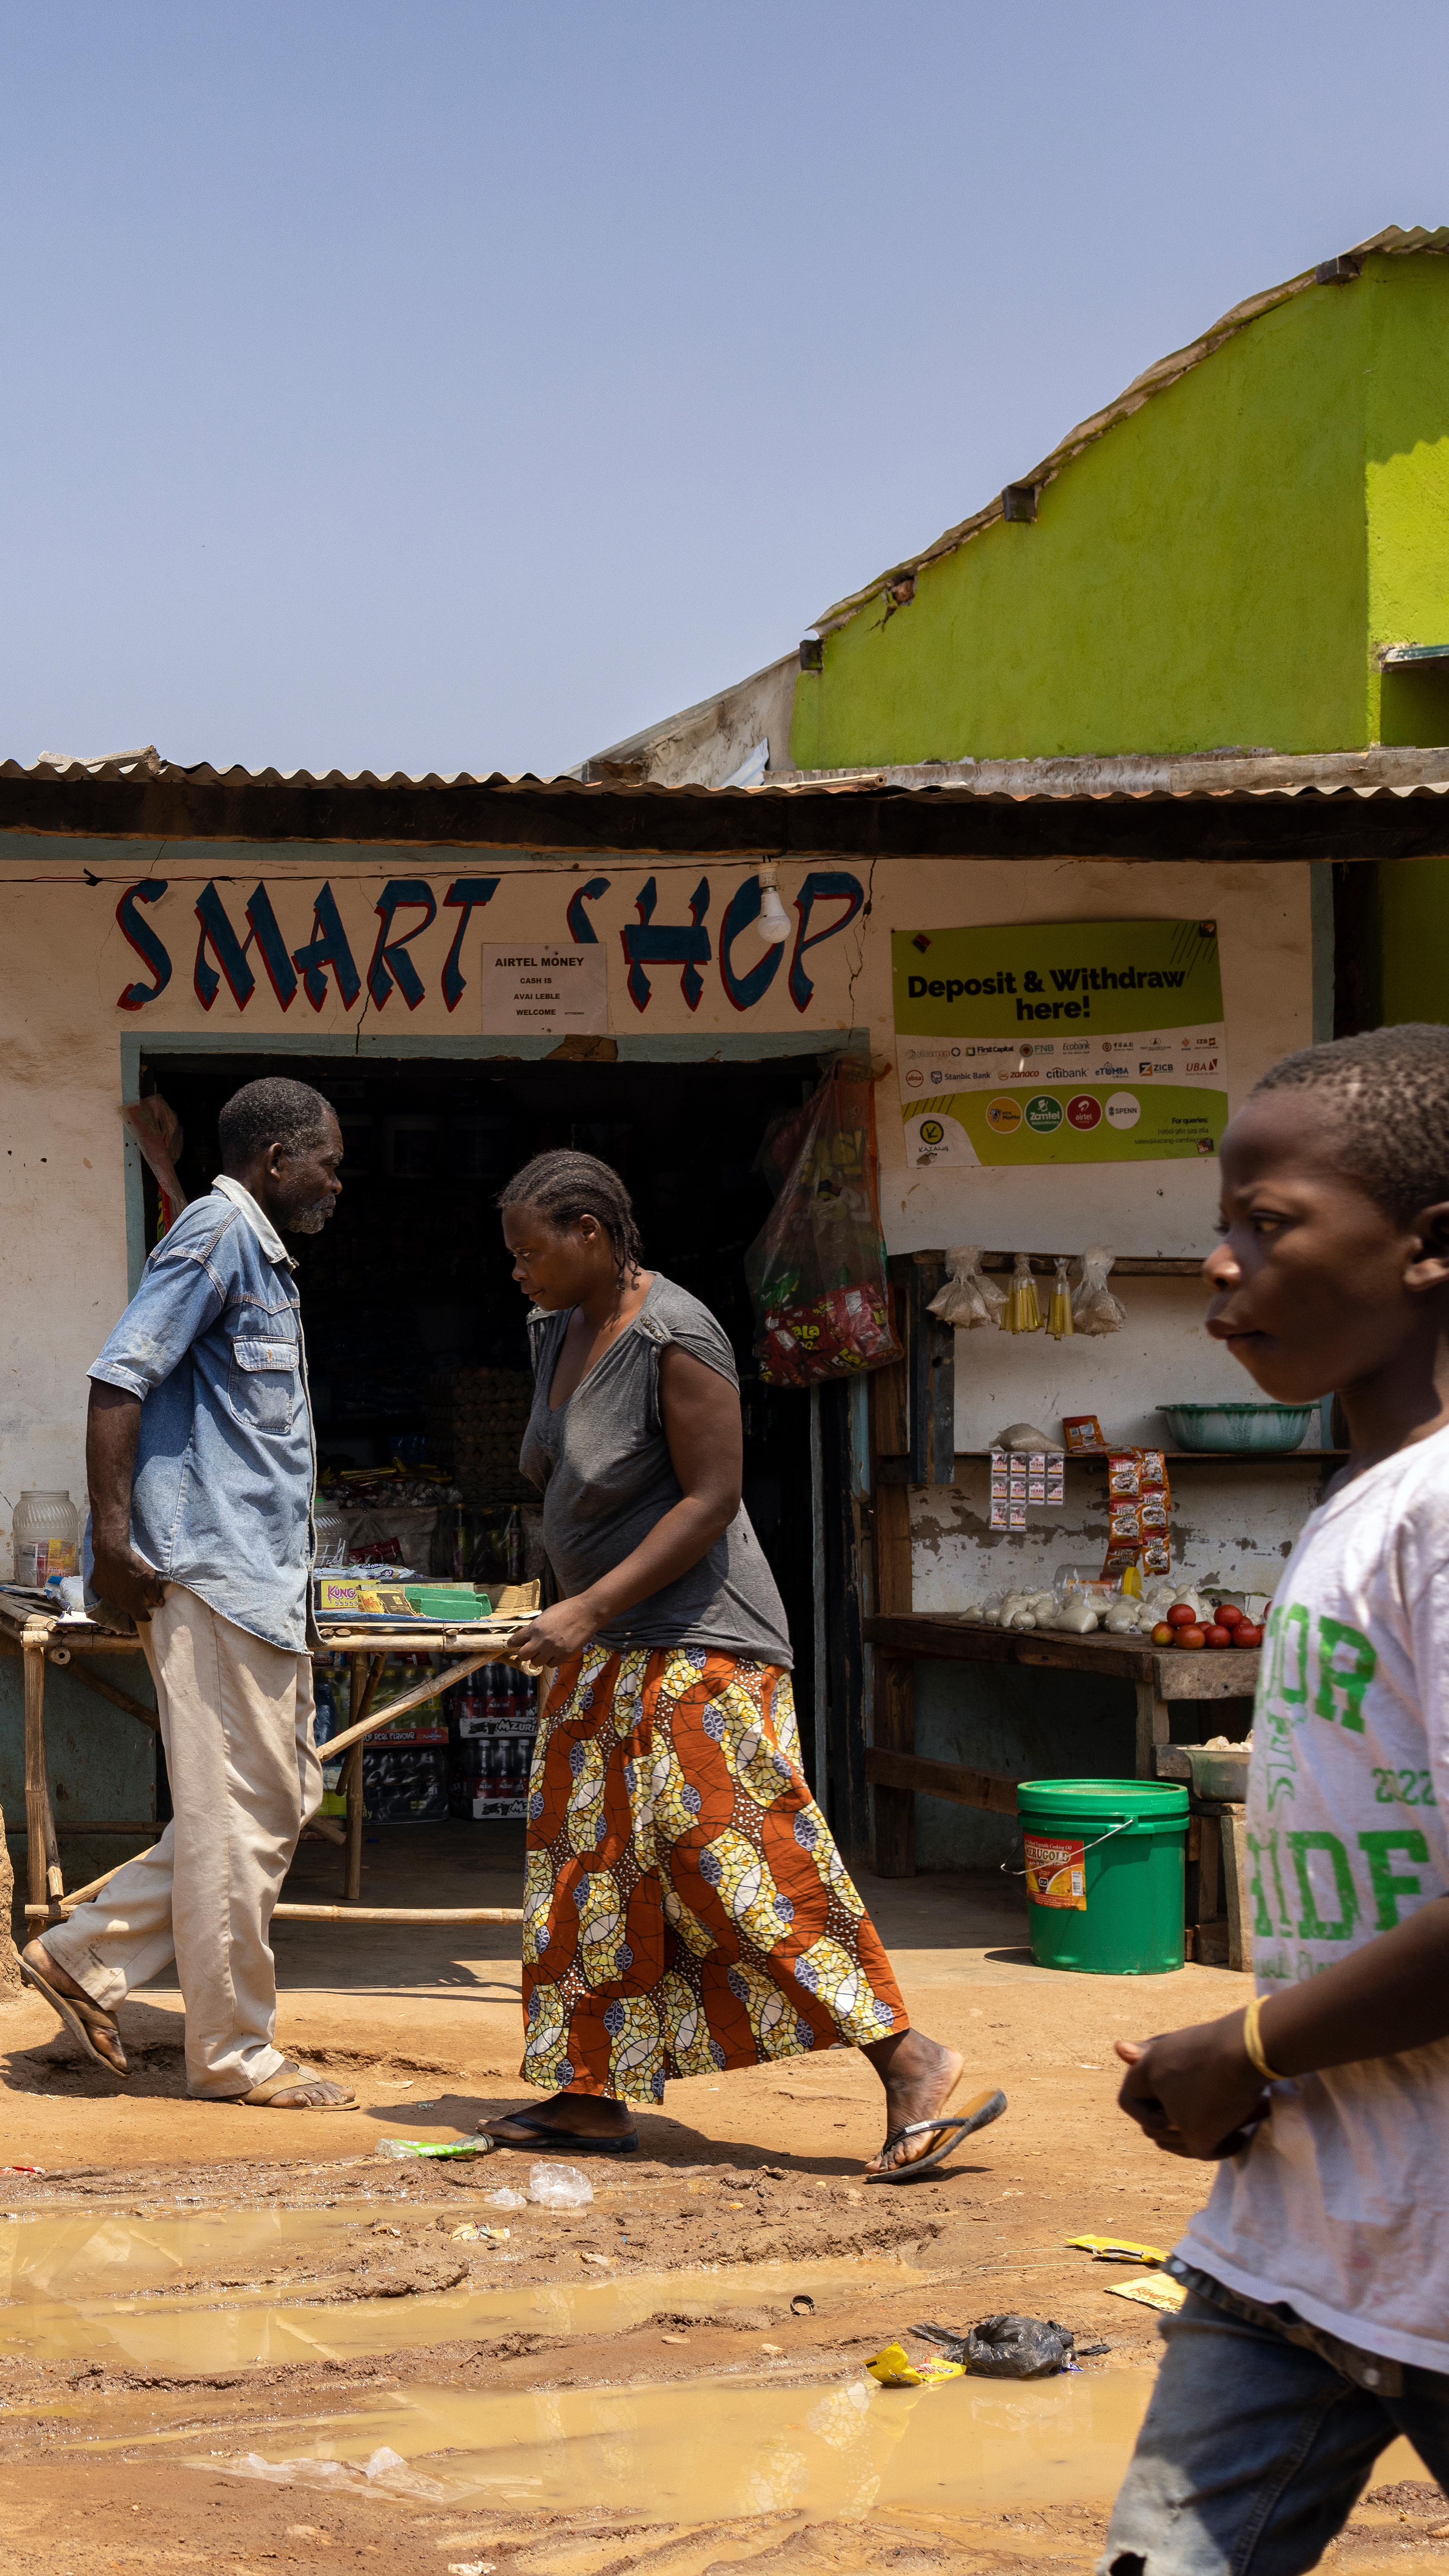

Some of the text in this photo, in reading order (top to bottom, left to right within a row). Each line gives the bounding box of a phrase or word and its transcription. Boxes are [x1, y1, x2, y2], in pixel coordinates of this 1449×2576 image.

[116, 871, 865, 1014] SMART SHOP
[495, 957, 584, 967] AIRTEL MONEY
[908, 966, 1185, 1003] Deposit & Withdraw
[1016, 996, 1091, 1021] here!
[1063, 1042, 1090, 1050] Ecobank
[1046, 1067, 1087, 1078] citibank
[1186, 1063, 1207, 1072] UBA
[1030, 1112, 1060, 1121] Zamtel
[327, 1585, 357, 1603] KUNG
